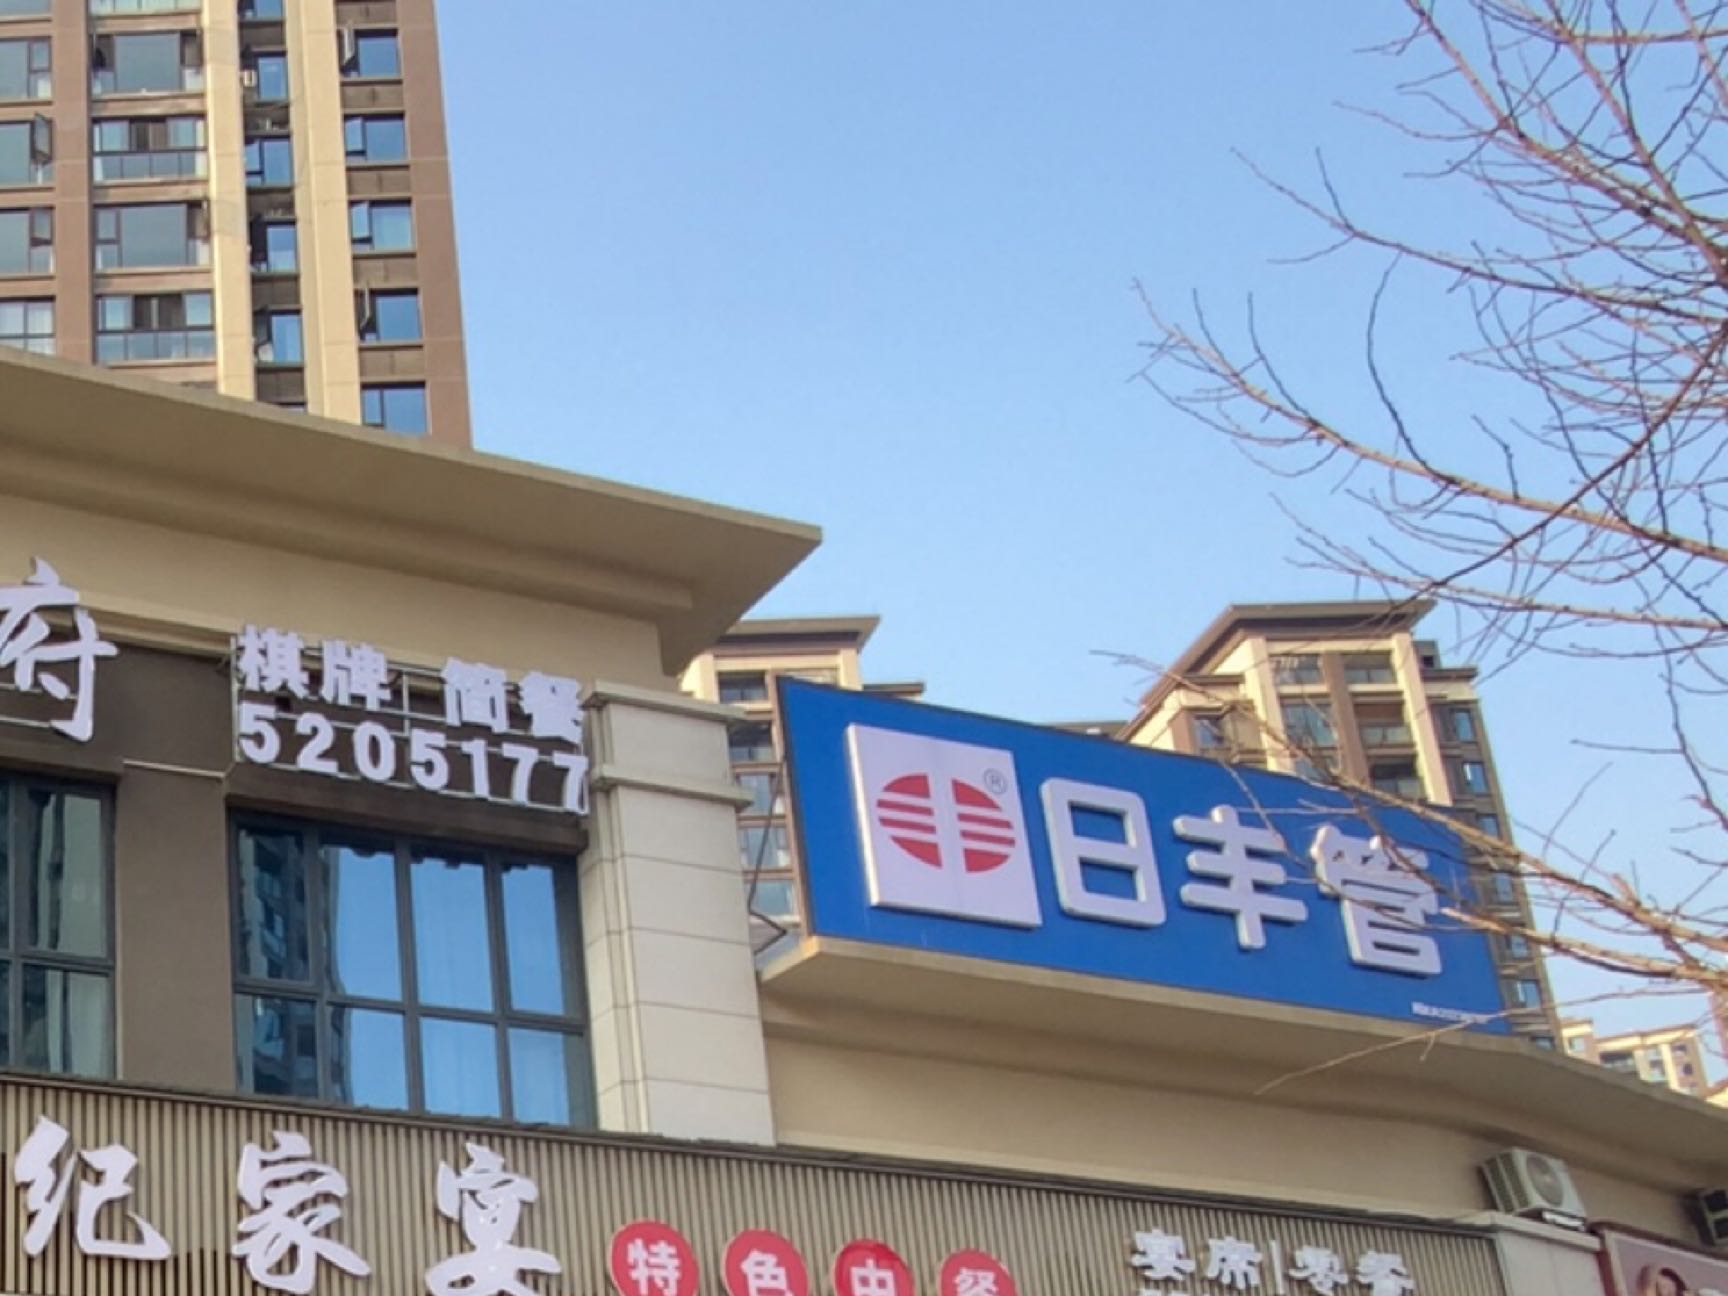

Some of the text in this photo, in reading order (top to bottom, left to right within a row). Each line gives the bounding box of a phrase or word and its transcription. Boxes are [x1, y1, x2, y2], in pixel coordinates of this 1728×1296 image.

[238, 624, 391, 711] 棋牌
[239, 702, 589, 815] 5205177
[1039, 776, 1443, 977] 日丰管
